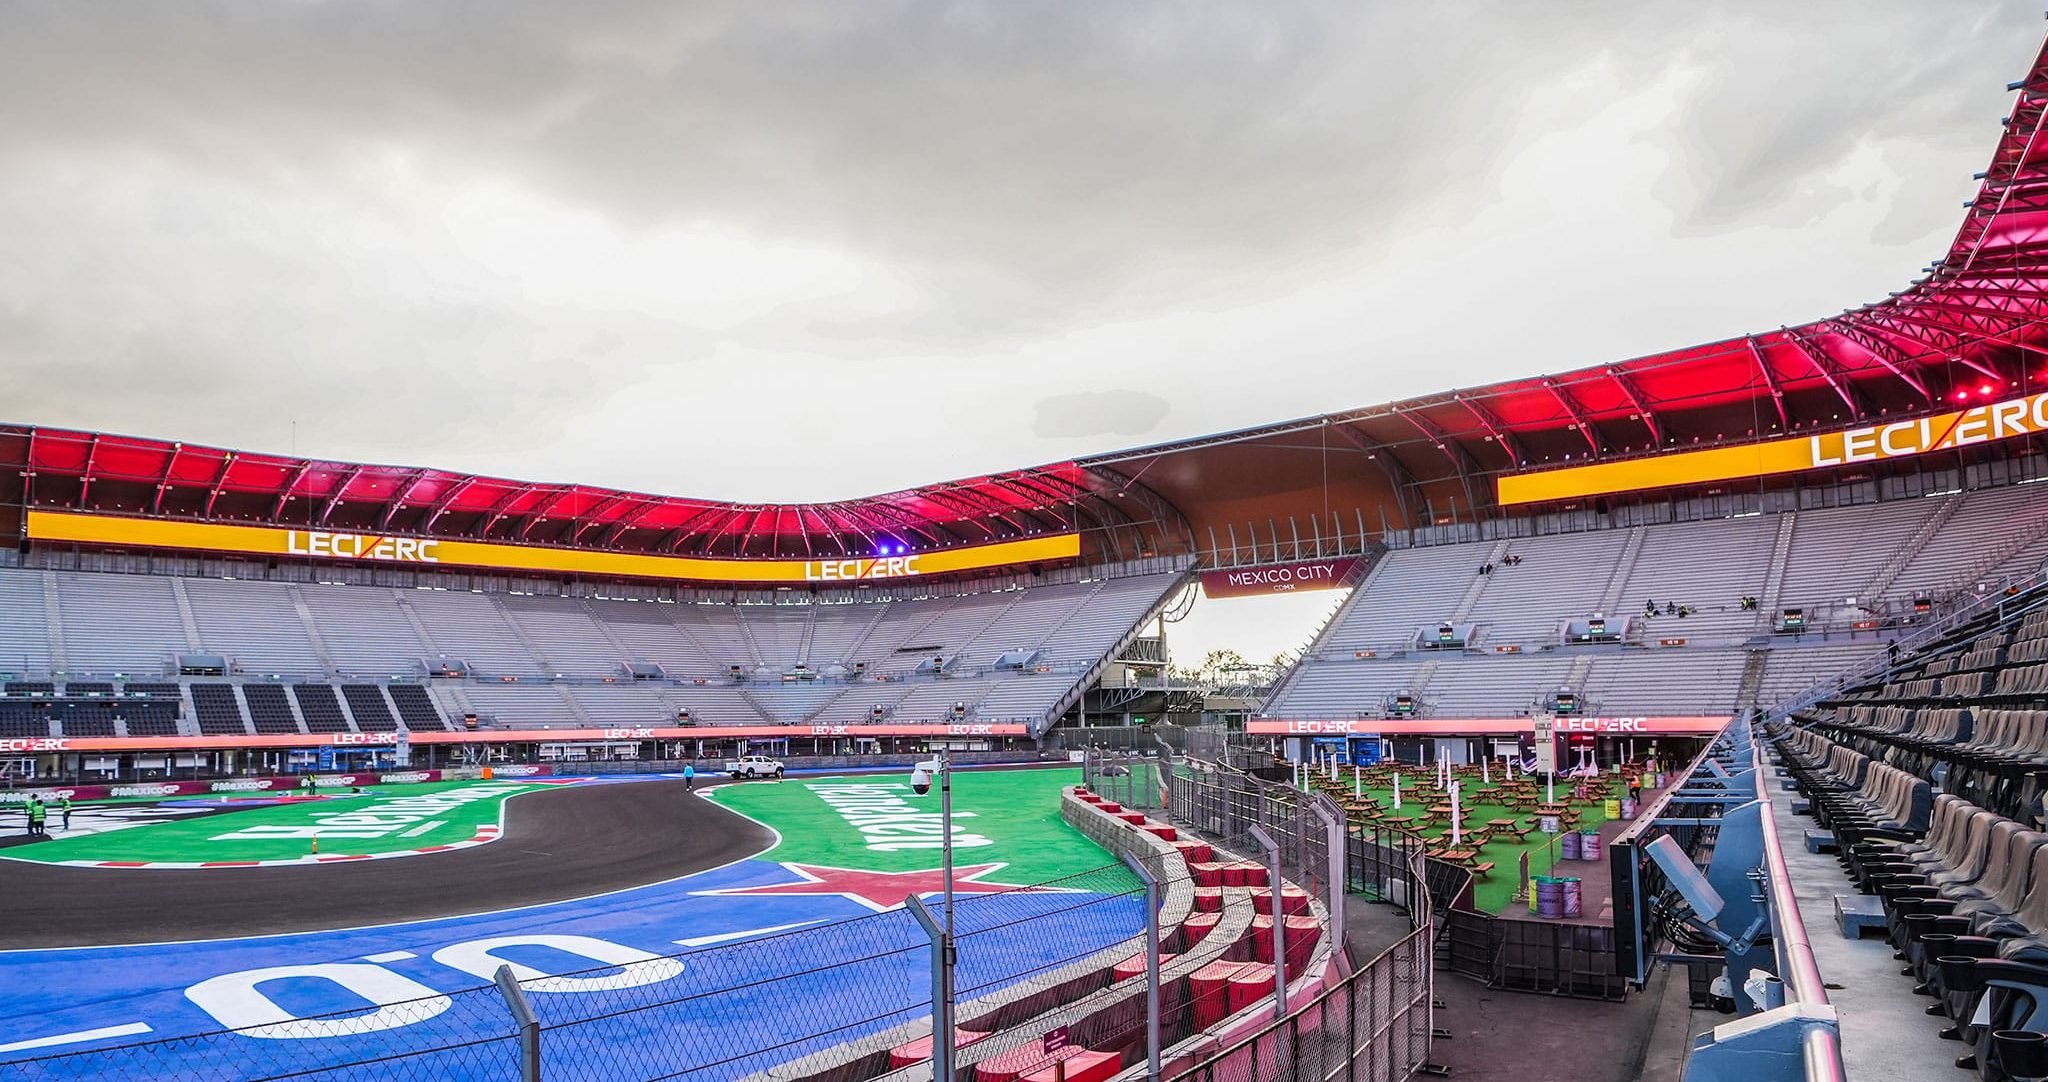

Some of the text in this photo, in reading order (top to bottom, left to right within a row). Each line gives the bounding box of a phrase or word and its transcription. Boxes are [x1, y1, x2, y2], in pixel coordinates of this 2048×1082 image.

[288, 531, 438, 562] LECLERC
[806, 555, 919, 581] LECLERC
[1229, 565, 1335, 587] MEXICO CITY
[811, 726, 848, 735] LECLERC
[948, 724, 993, 735] LECLERC
[1289, 721, 1358, 733] LECLERC
[1557, 717, 1648, 731] LECLERC
[604, 728, 655, 739] LECLERC
[110, 785, 180, 798] #MexicoGP
[804, 783, 994, 852] Heineken
